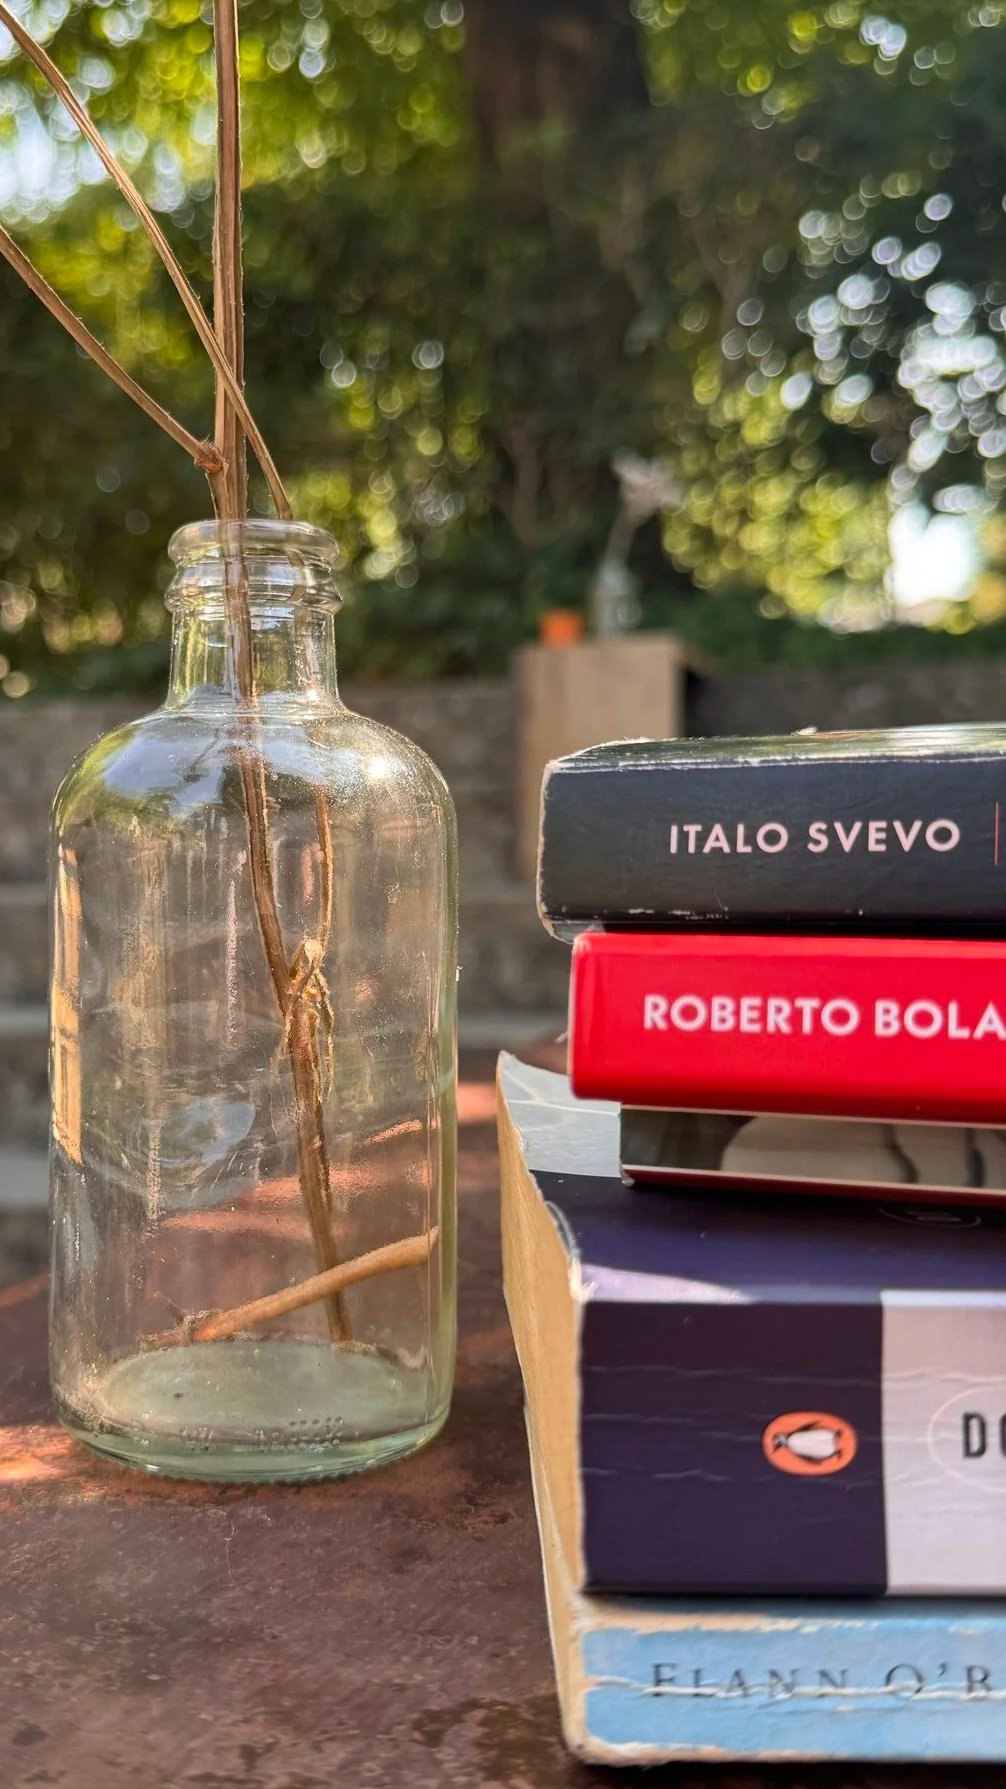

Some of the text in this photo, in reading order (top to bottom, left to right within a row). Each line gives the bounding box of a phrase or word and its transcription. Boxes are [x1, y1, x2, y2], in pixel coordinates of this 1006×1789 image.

[669, 819, 961, 854] ITALO SVEVO
[643, 994, 1006, 1040] ROBERTO BOLA
[651, 1661, 849, 1699] FLANN
